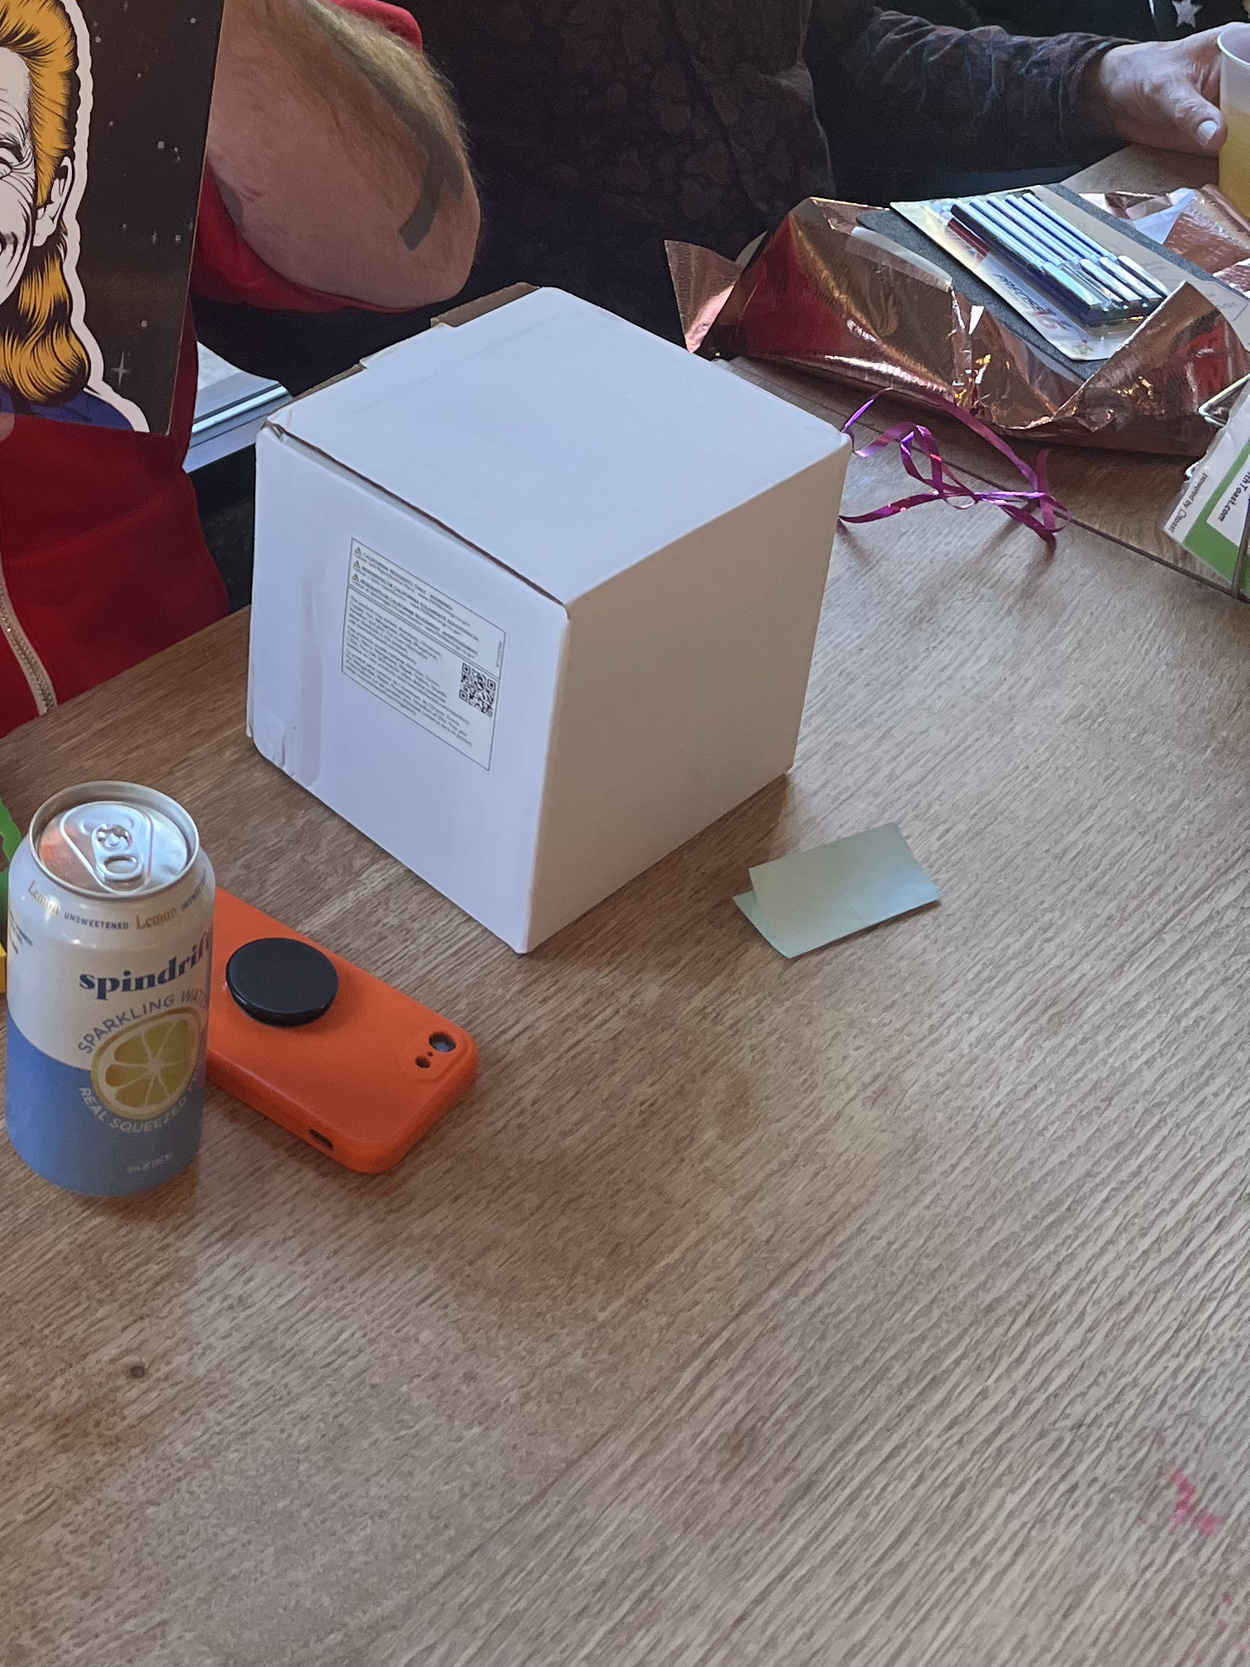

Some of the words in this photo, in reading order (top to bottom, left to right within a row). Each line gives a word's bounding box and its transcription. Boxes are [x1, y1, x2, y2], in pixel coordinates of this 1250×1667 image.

[1183, 499, 1193, 509] by
[1189, 472, 1208, 502] powered
[27, 879, 61, 916] Lemon
[64, 911, 130, 930] UNSWEETENED
[135, 907, 178, 930] Lemon
[78, 994, 175, 1054] SPARKLING
[79, 1087, 108, 1122] REAL
[109, 1096, 187, 1133] SQUEEZED
